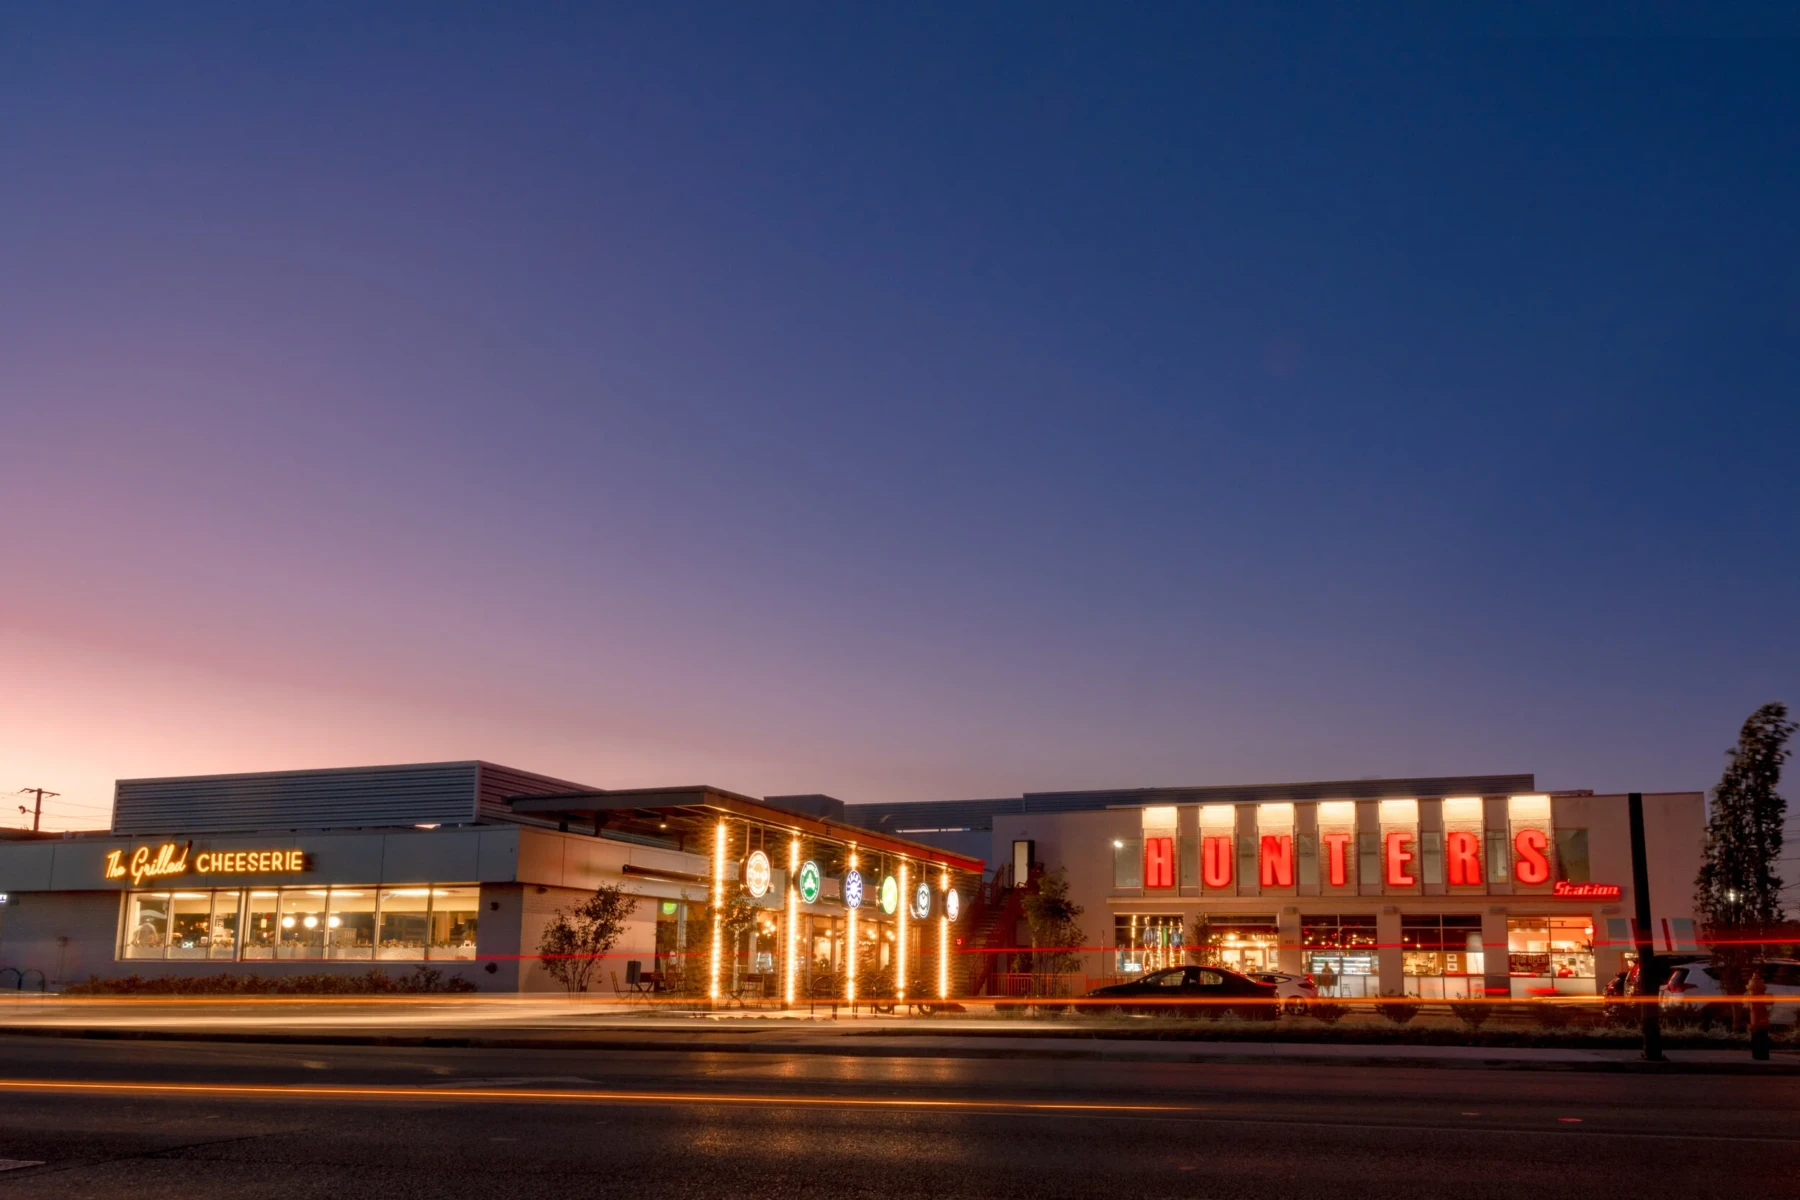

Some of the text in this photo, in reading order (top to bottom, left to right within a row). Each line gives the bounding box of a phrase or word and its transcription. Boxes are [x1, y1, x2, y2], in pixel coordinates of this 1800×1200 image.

[105, 844, 303, 886] The Grilled CHEESERIE
[1146, 829, 1549, 888] HUNTERS
[1553, 881, 1620, 896] Station
